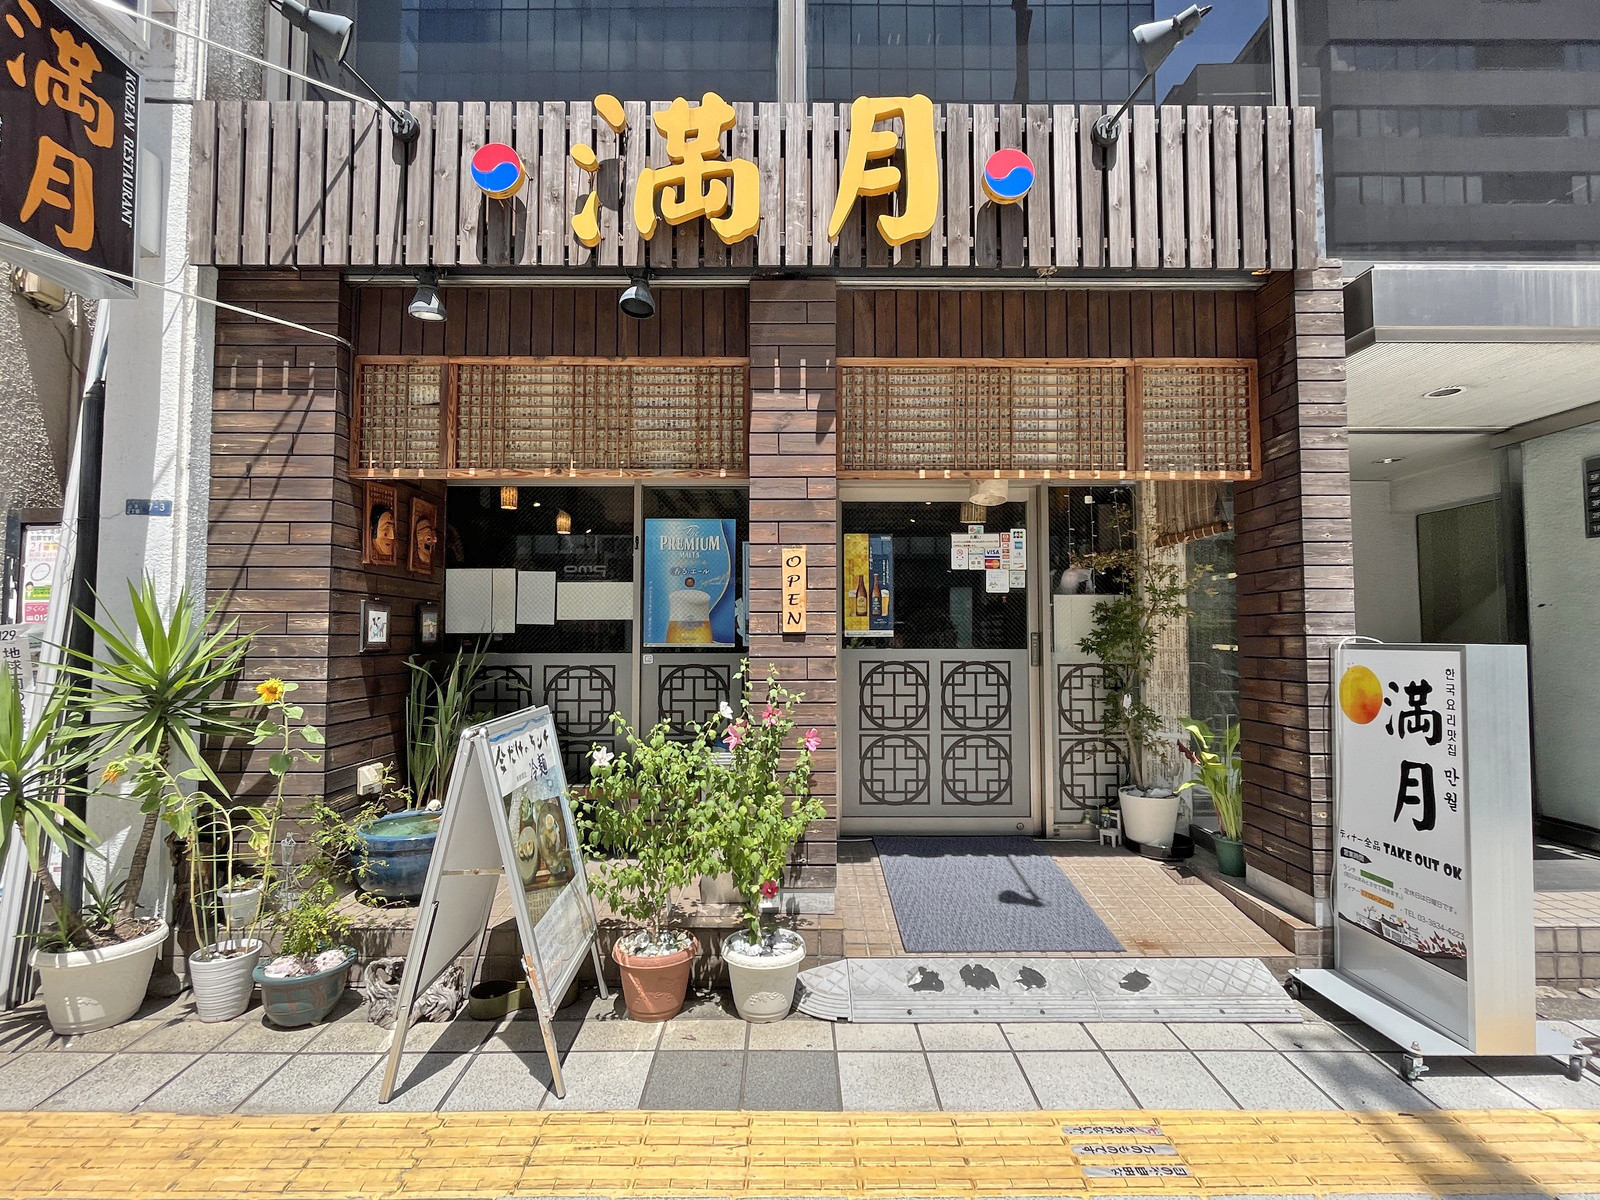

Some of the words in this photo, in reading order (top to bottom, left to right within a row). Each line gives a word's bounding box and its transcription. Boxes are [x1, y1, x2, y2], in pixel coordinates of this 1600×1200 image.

[5, 0, 114, 251] 満月
[124, 70, 137, 132] KOREAN
[121, 134, 134, 228] RESTAURANT
[569, 91, 940, 248] 満月
[659, 535, 721, 551] PREMIUM
[786, 555, 803, 626] OPEN
[1445, 668, 1457, 757] 한국요리맛집
[1384, 679, 1443, 832] 満月
[1443, 767, 1460, 813] 만월
[1382, 842, 1413, 863] TAKE
[1414, 853, 1440, 872] OUT
[1443, 863, 1463, 880] OK
[1404, 908, 1416, 919] TEL
[1417, 913, 1465, 941] 03-3834-4223
